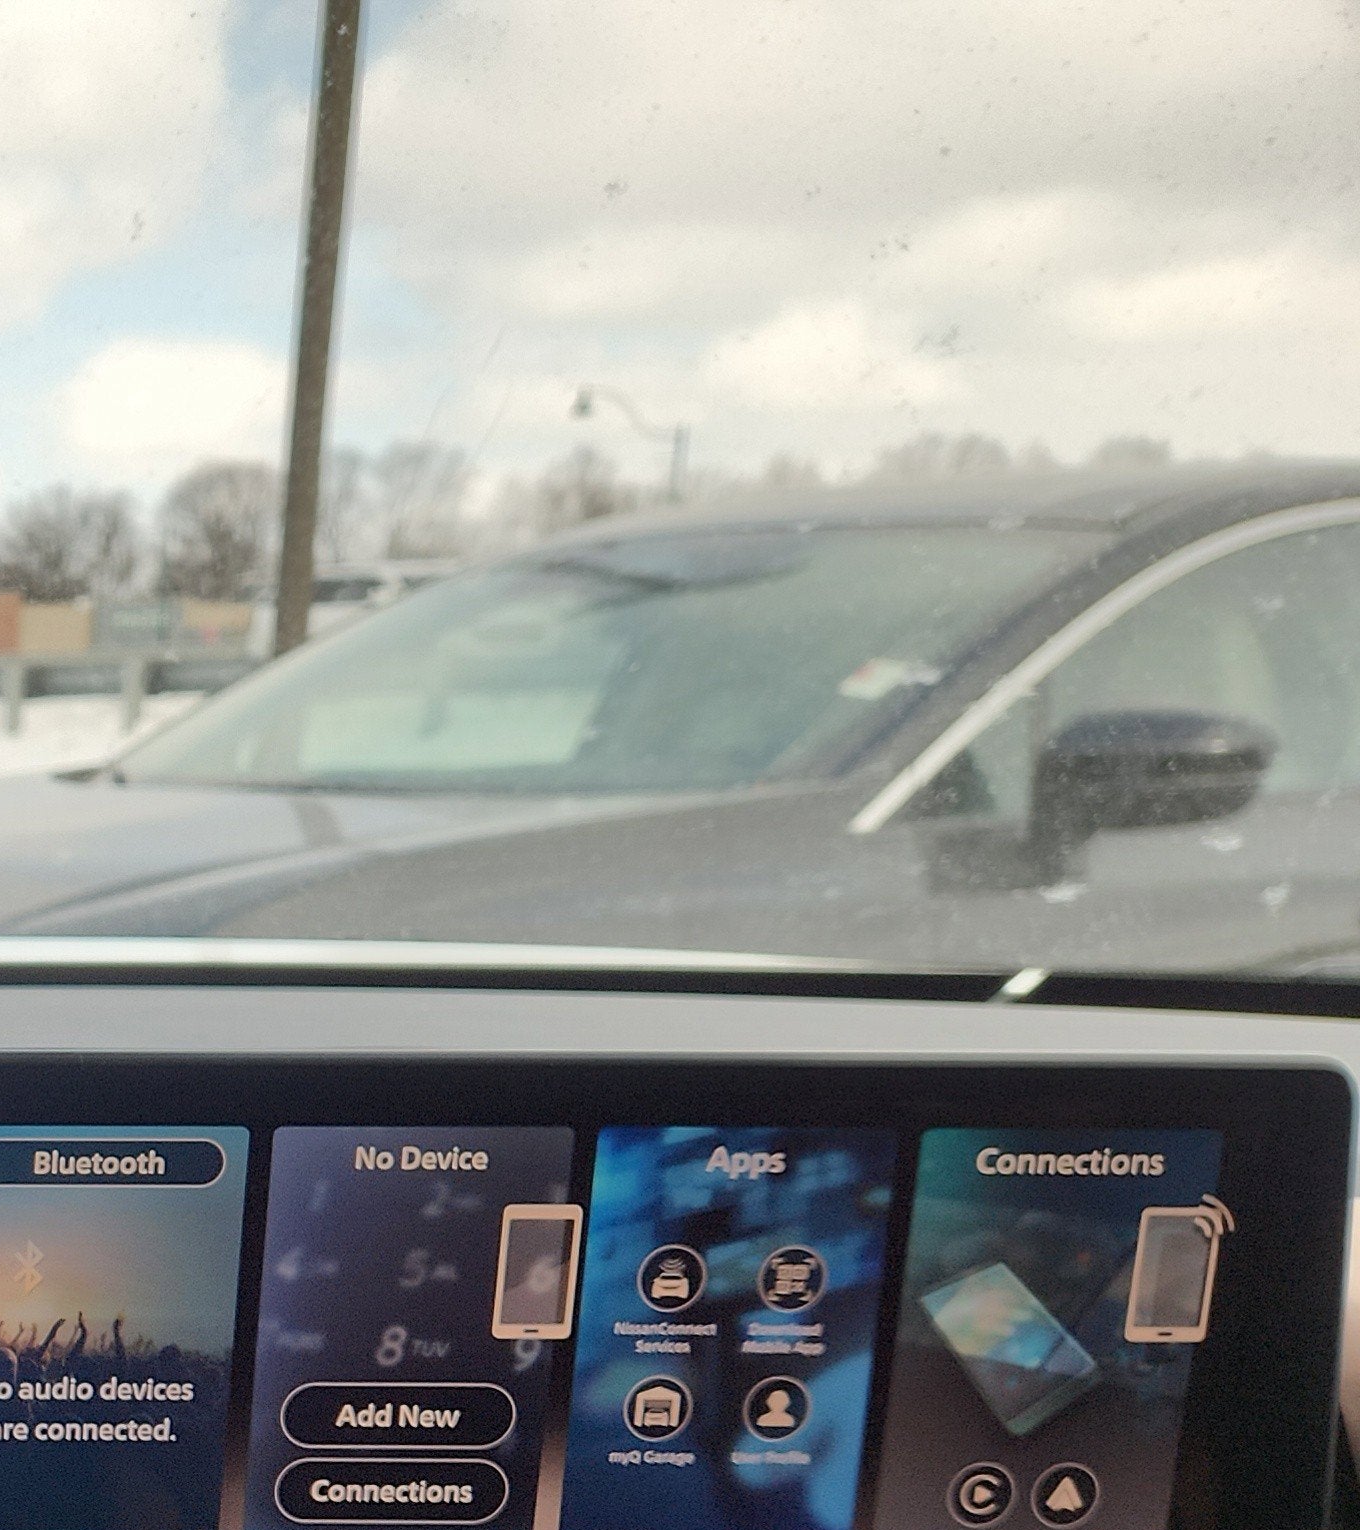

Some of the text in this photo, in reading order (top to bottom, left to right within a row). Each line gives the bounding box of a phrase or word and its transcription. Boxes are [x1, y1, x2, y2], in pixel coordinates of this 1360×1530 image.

[32, 1150, 166, 1177] Bluetooth
[354, 1145, 490, 1171] No Device
[705, 1146, 787, 1180] Apps
[976, 1146, 1165, 1177] Connections
[375, 1325, 408, 1367] 8
[18, 1376, 90, 1402] audio
[100, 1376, 194, 1402] devices
[335, 1403, 461, 1428] Add New
[35, 1416, 177, 1443] connected.
[311, 1478, 473, 1504] Connections
